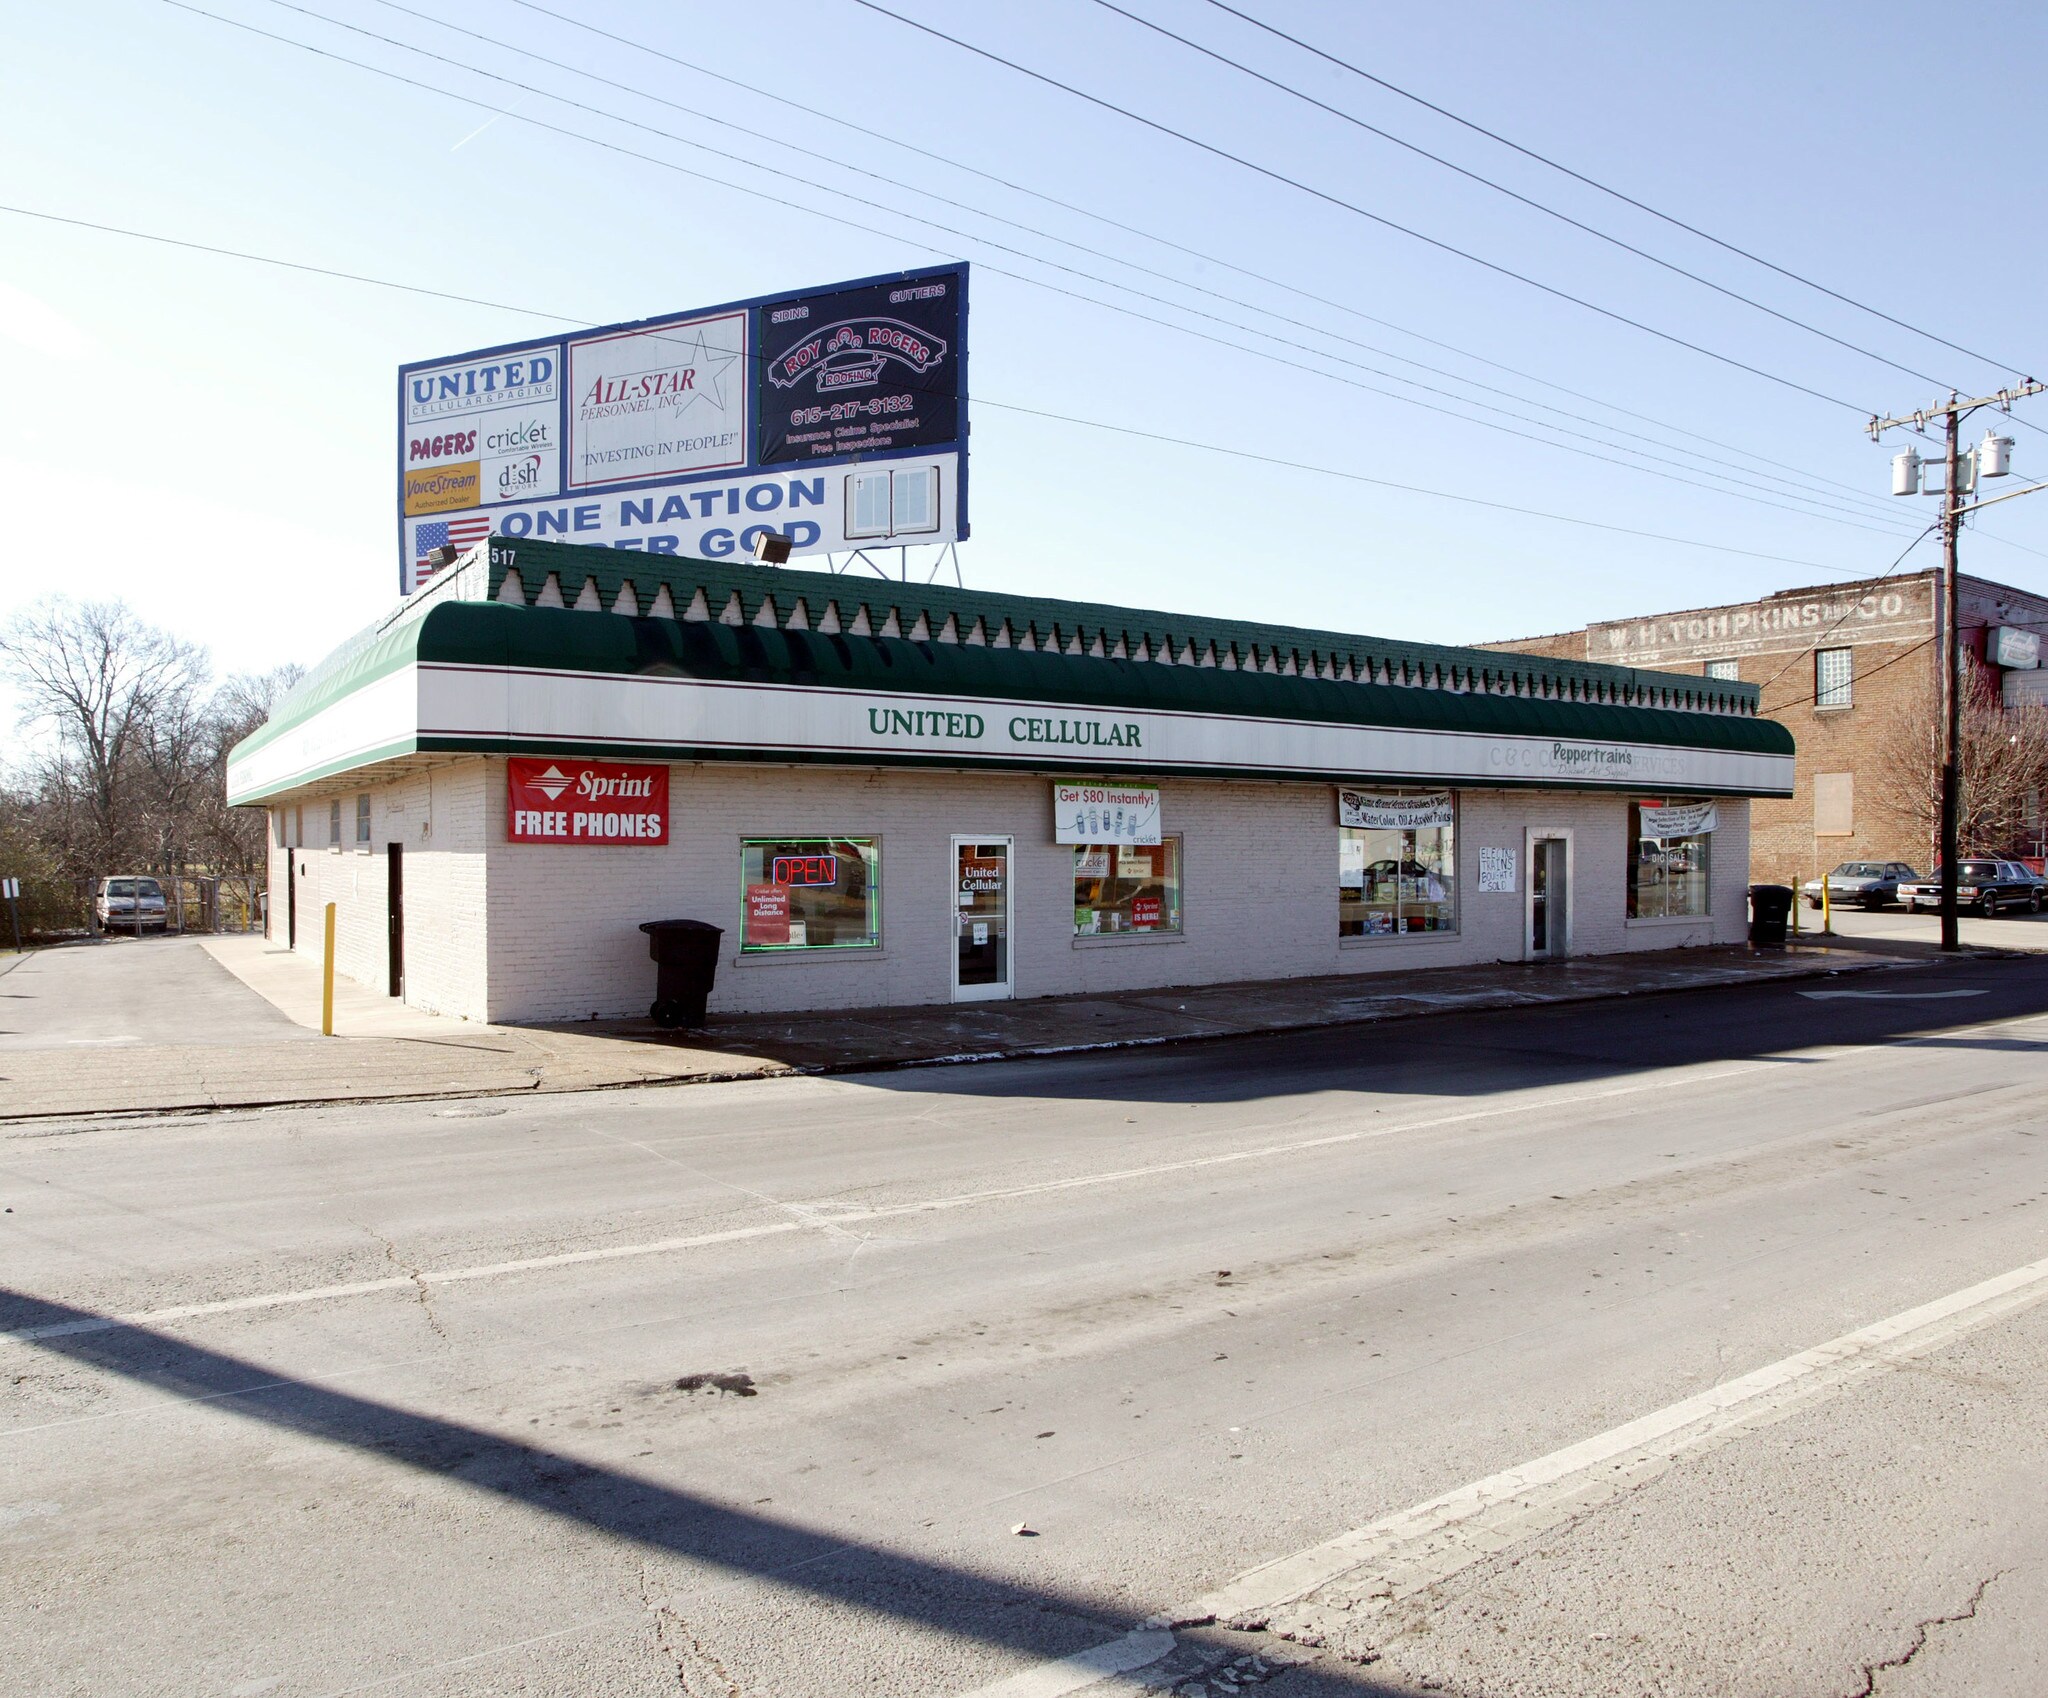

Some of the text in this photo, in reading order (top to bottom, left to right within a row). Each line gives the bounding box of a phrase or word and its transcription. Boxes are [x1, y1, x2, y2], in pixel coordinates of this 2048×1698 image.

[889, 284, 946, 303] GUTTERS
[771, 307, 809, 324] SIDING
[783, 327, 930, 376] ROY ROGERS
[413, 357, 553, 403] UNITED
[825, 368, 872, 386] ROOFING
[581, 368, 696, 408] ALL-STAR
[580, 393, 683, 421] PERSONNEL, INC.
[790, 394, 914, 426] 615-217-3132
[786, 418, 920, 445] Insurance Claims Specialist
[409, 429, 477, 461] PAGERS
[658, 441, 673, 455] IN
[811, 435, 892, 455] Free Inspections
[499, 462, 538, 487] dish
[415, 496, 470, 509] Authorized Dealer
[499, 477, 825, 538] ONE NATION
[491, 547, 516, 566] 517
[1668, 602, 1819, 643] TOMPKINS
[868, 708, 1142, 748] UNITED CELLULAR
[1553, 743, 1632, 765] Peppertrain's
[576, 770, 653, 802] Sprint
[1060, 788, 1154, 808] Get $80 Instantly!
[514, 810, 661, 838] FREE PHONES
[1133, 834, 1157, 844] cricket
[1481, 858, 1513, 871] TRAINS
[1669, 853, 1686, 862] SALE
[775, 859, 834, 884] OPEN
[965, 867, 999, 878] United
[962, 879, 1002, 891] Cellular
[1487, 881, 1506, 892] SOLD
[751, 895, 786, 903] Unlimited
[760, 902, 778, 910] Long
[1143, 903, 1158, 911] Sprint
